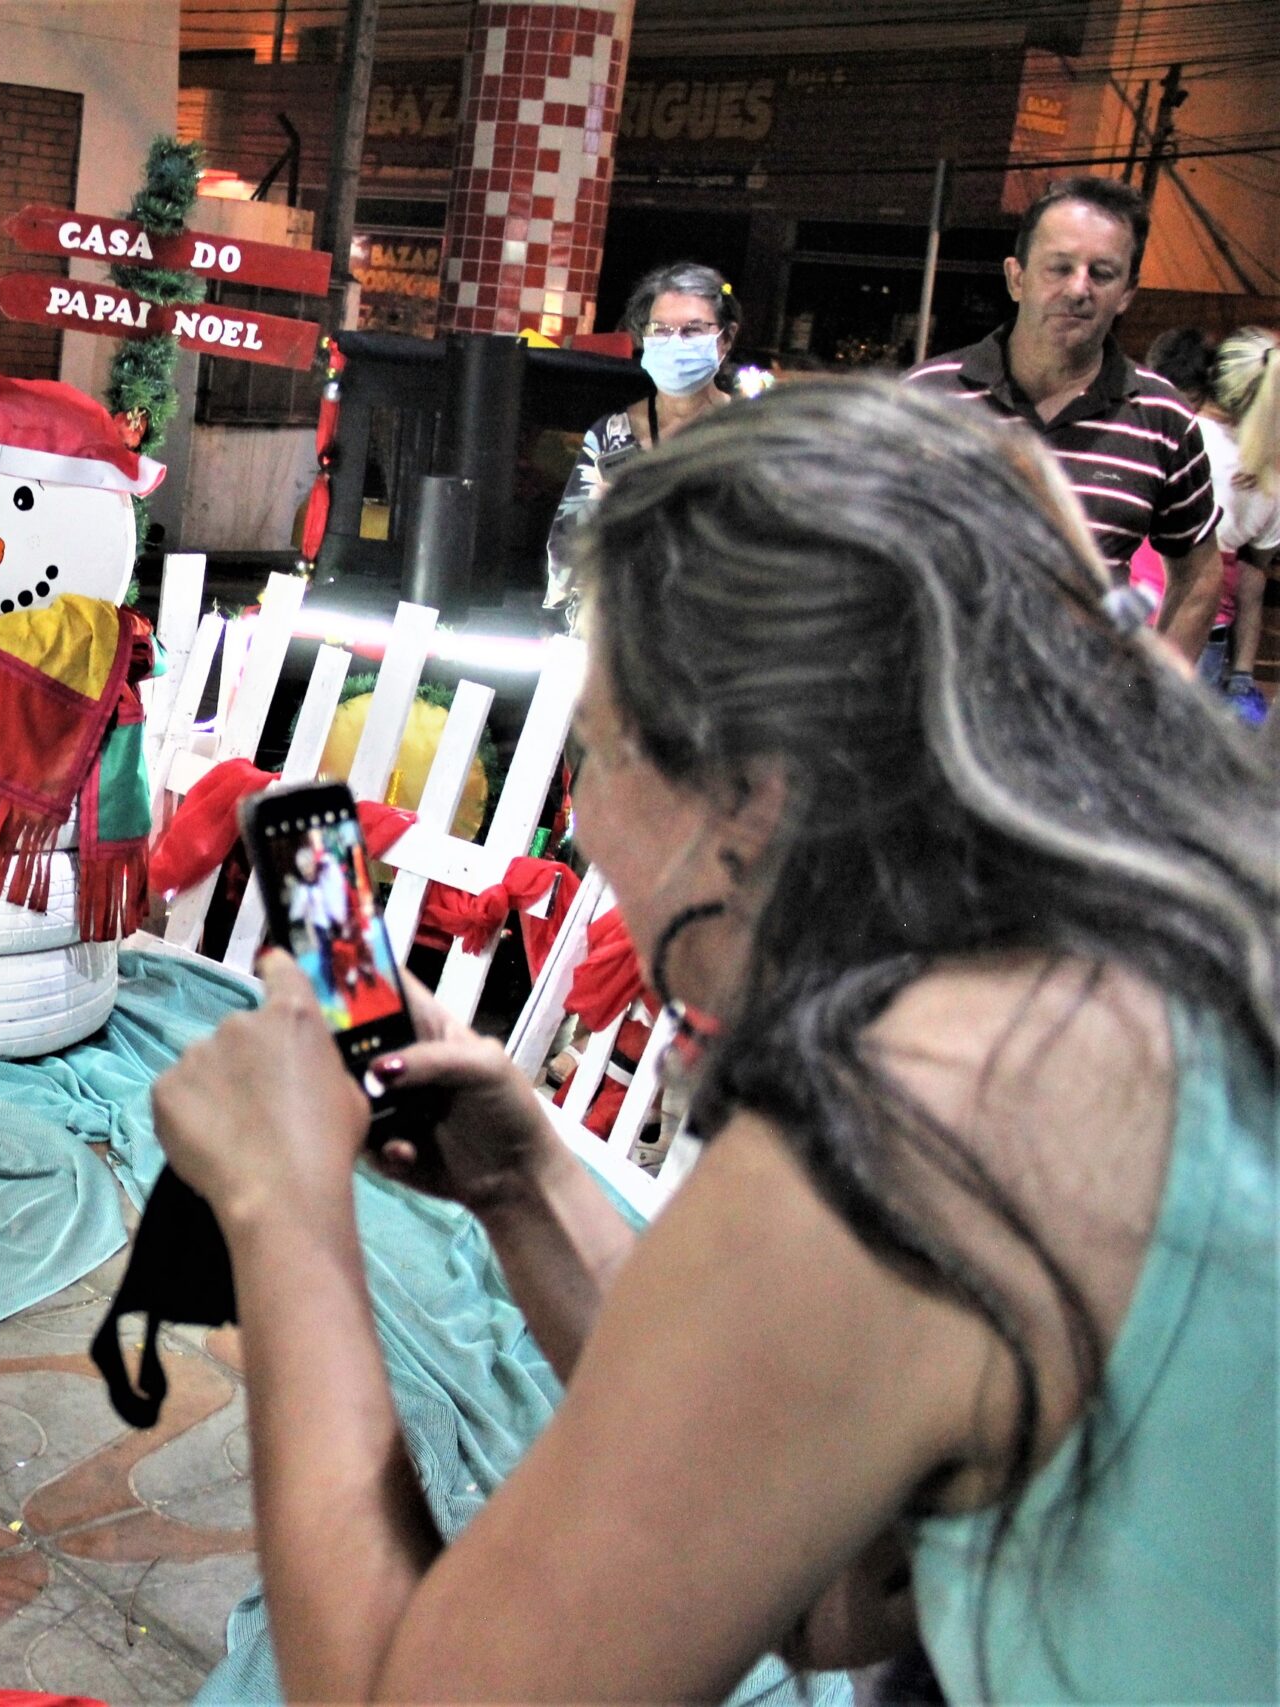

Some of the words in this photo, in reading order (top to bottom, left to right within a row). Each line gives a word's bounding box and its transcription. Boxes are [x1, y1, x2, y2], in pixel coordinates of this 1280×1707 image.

[58, 222, 153, 260] CASA
[191, 241, 241, 272] DO
[370, 244, 438, 270] BAZAR
[46, 287, 151, 328] PAPAI
[172, 311, 262, 350] NOEL
